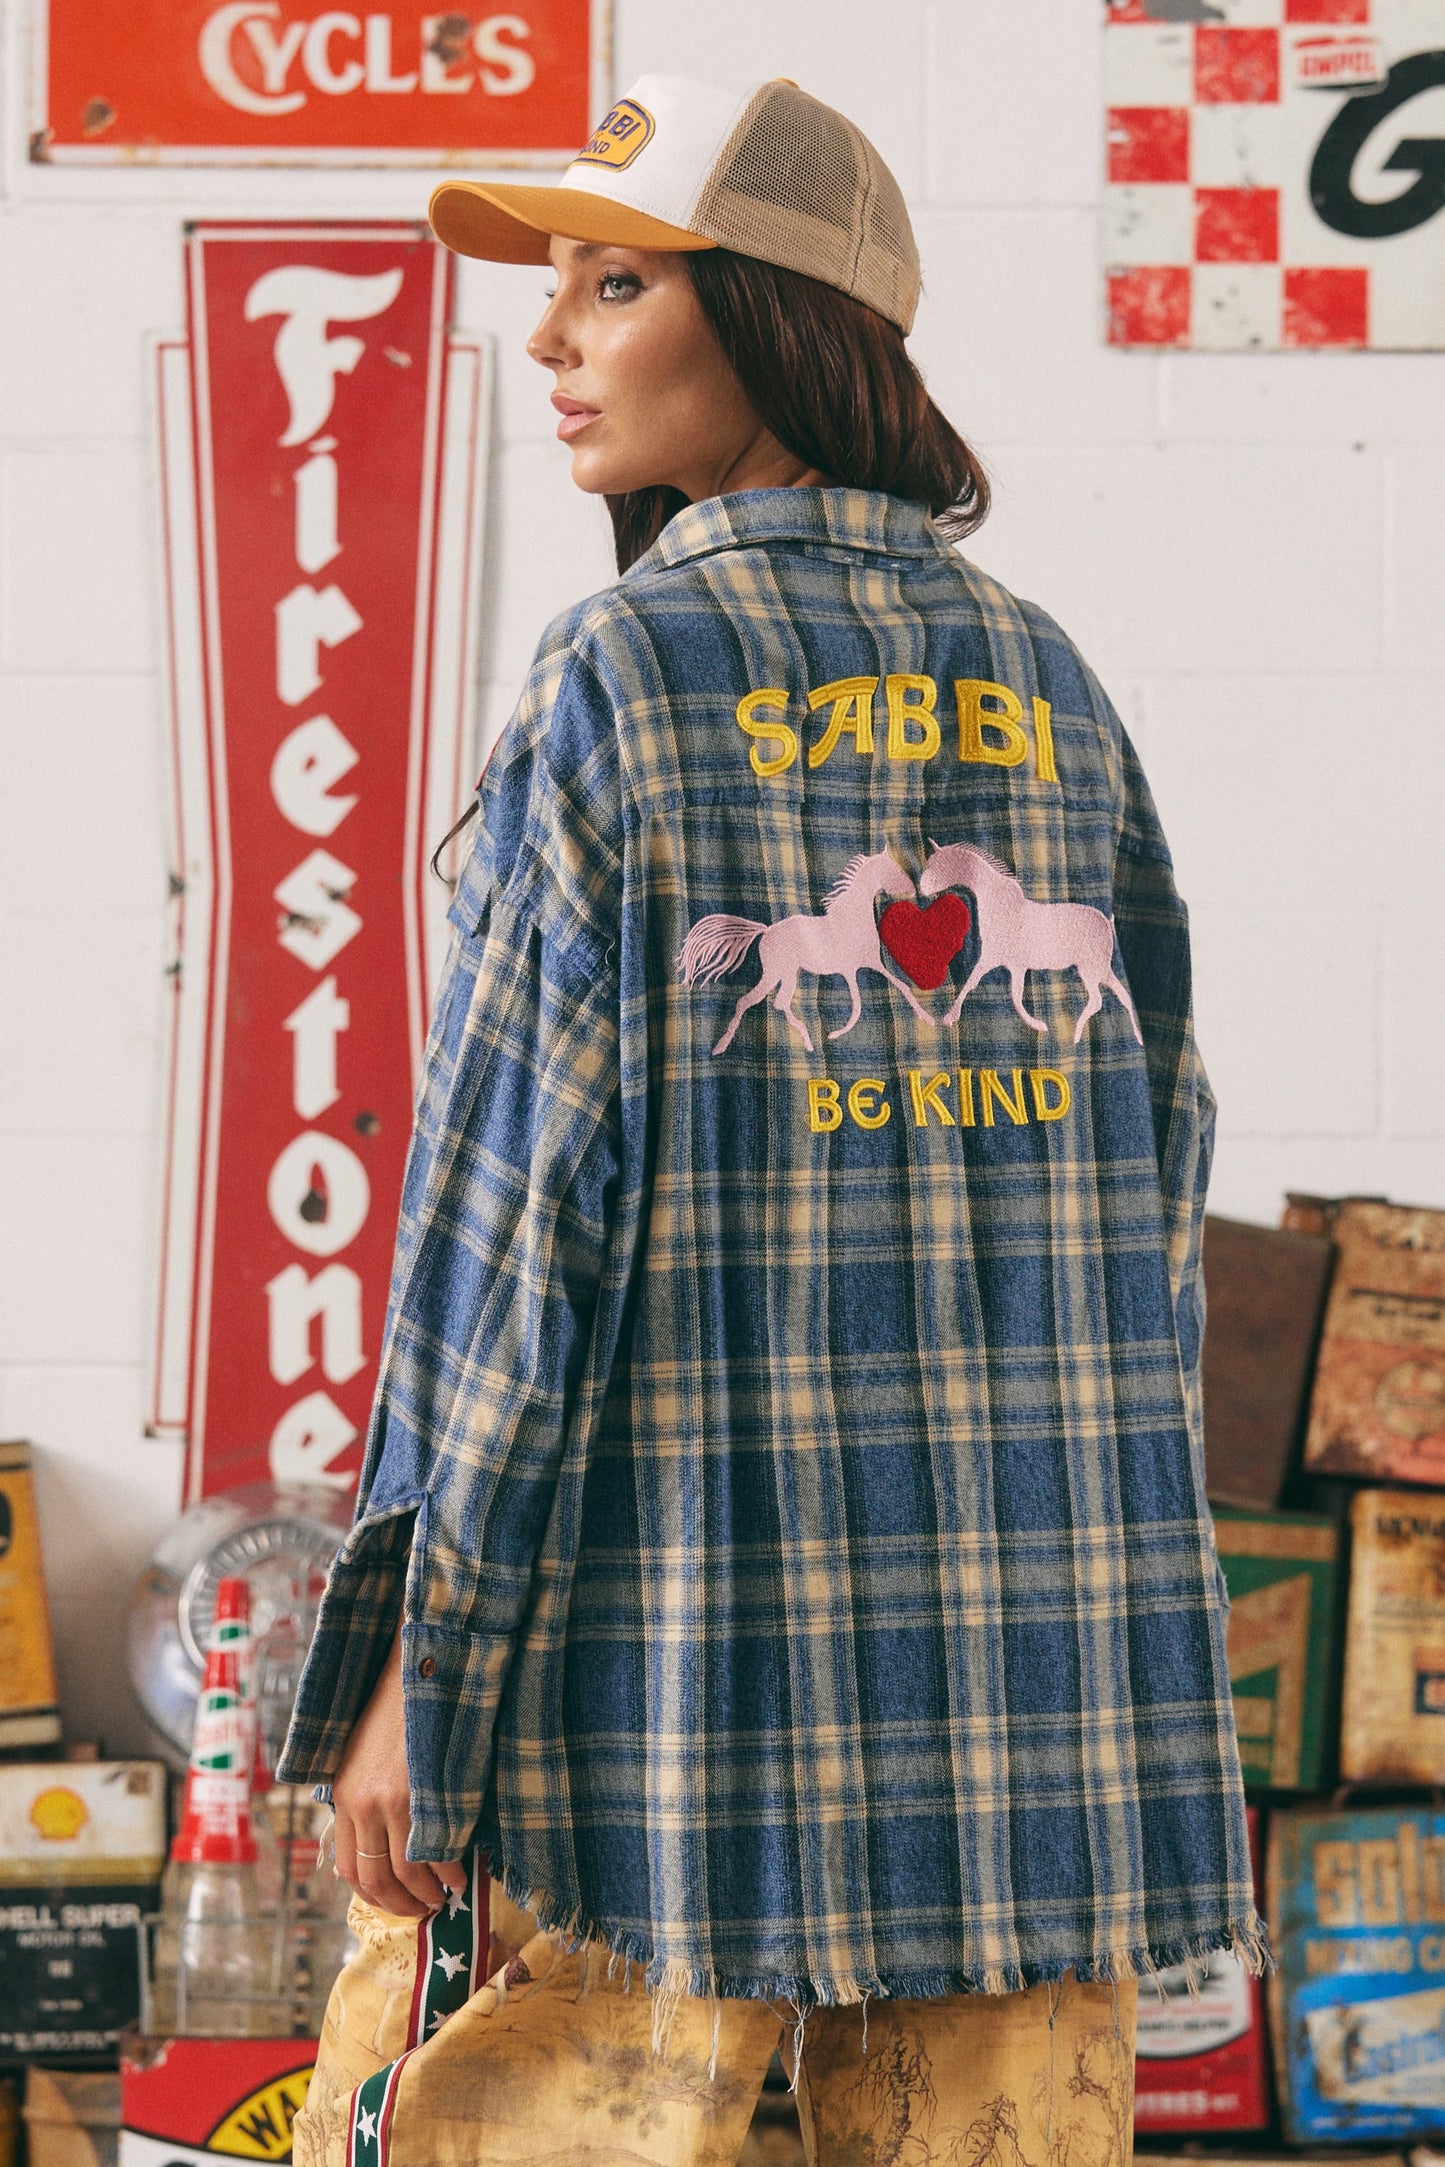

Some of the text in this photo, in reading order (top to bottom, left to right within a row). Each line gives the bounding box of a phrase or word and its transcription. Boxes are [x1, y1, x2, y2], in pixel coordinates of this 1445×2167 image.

[200, 2, 536, 116] CYCLES
[736, 673, 1058, 782] SABBI
[244, 264, 404, 1489] Firestone
[806, 1068, 1071, 1133] BE KIND
[237, 2080, 309, 2150] WA
